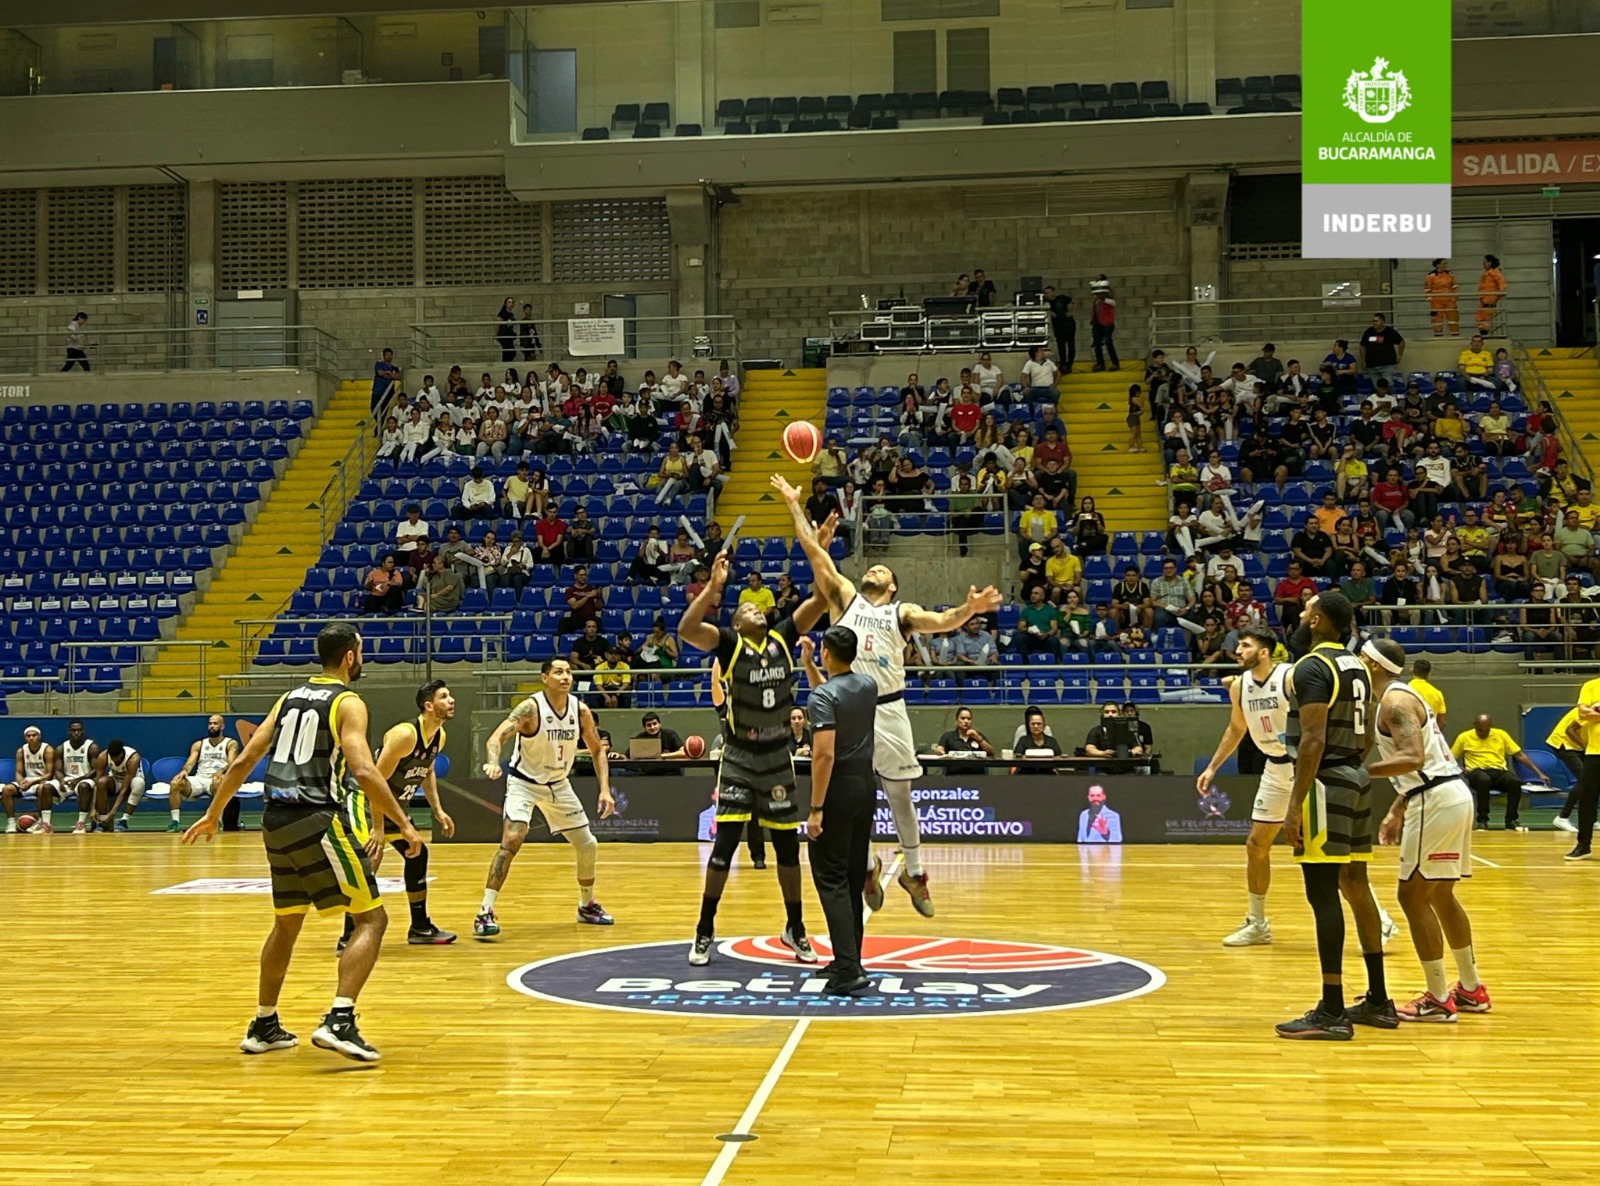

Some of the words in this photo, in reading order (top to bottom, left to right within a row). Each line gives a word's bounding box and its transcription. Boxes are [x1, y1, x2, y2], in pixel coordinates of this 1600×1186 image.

[1463, 153, 1560, 176] SALIDA
[854, 614, 891, 631] TITANES
[864, 634, 874, 651] 6
[762, 688, 775, 708] 8
[1248, 696, 1279, 712] TITANES
[1353, 678, 1365, 734] 3
[1261, 716, 1272, 733] 10
[273, 708, 319, 765] 10
[546, 729, 575, 741] TITANES
[558, 745, 563, 761] 3
[398, 785, 418, 800] 25
[917, 805, 985, 821] LÁSTICO
[876, 821, 1024, 835] RENSTRUCTIVO
